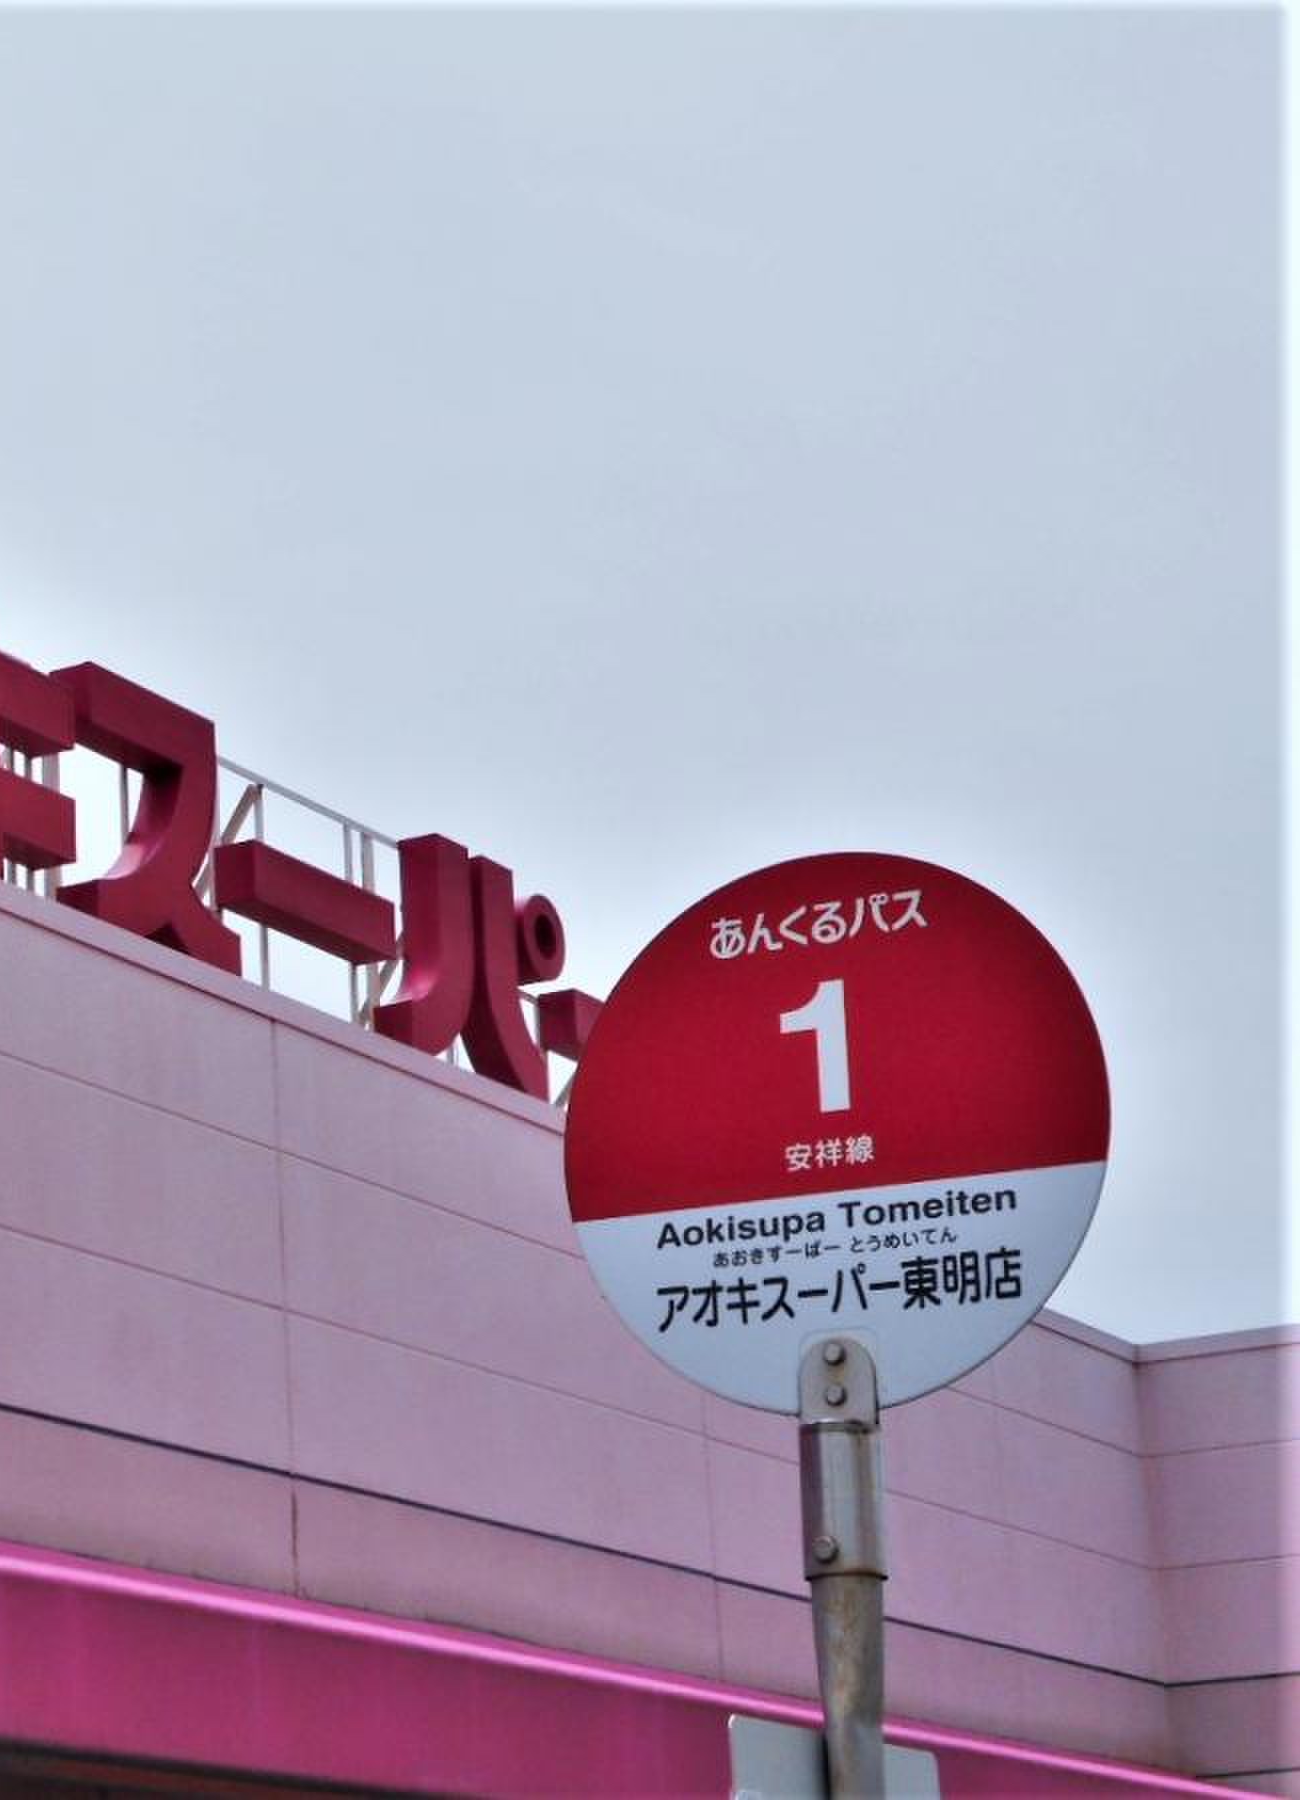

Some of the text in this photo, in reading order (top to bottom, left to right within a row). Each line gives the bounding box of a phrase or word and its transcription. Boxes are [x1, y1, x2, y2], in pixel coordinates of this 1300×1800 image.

[779, 978, 851, 1114] 1
[785, 1134, 874, 1172] 安祥線
[656, 1189, 1017, 1249] Aokisupa Tomeiten
[850, 1227, 957, 1253] とうめいてん
[656, 1247, 1023, 1332] アオキスーパー東明店
